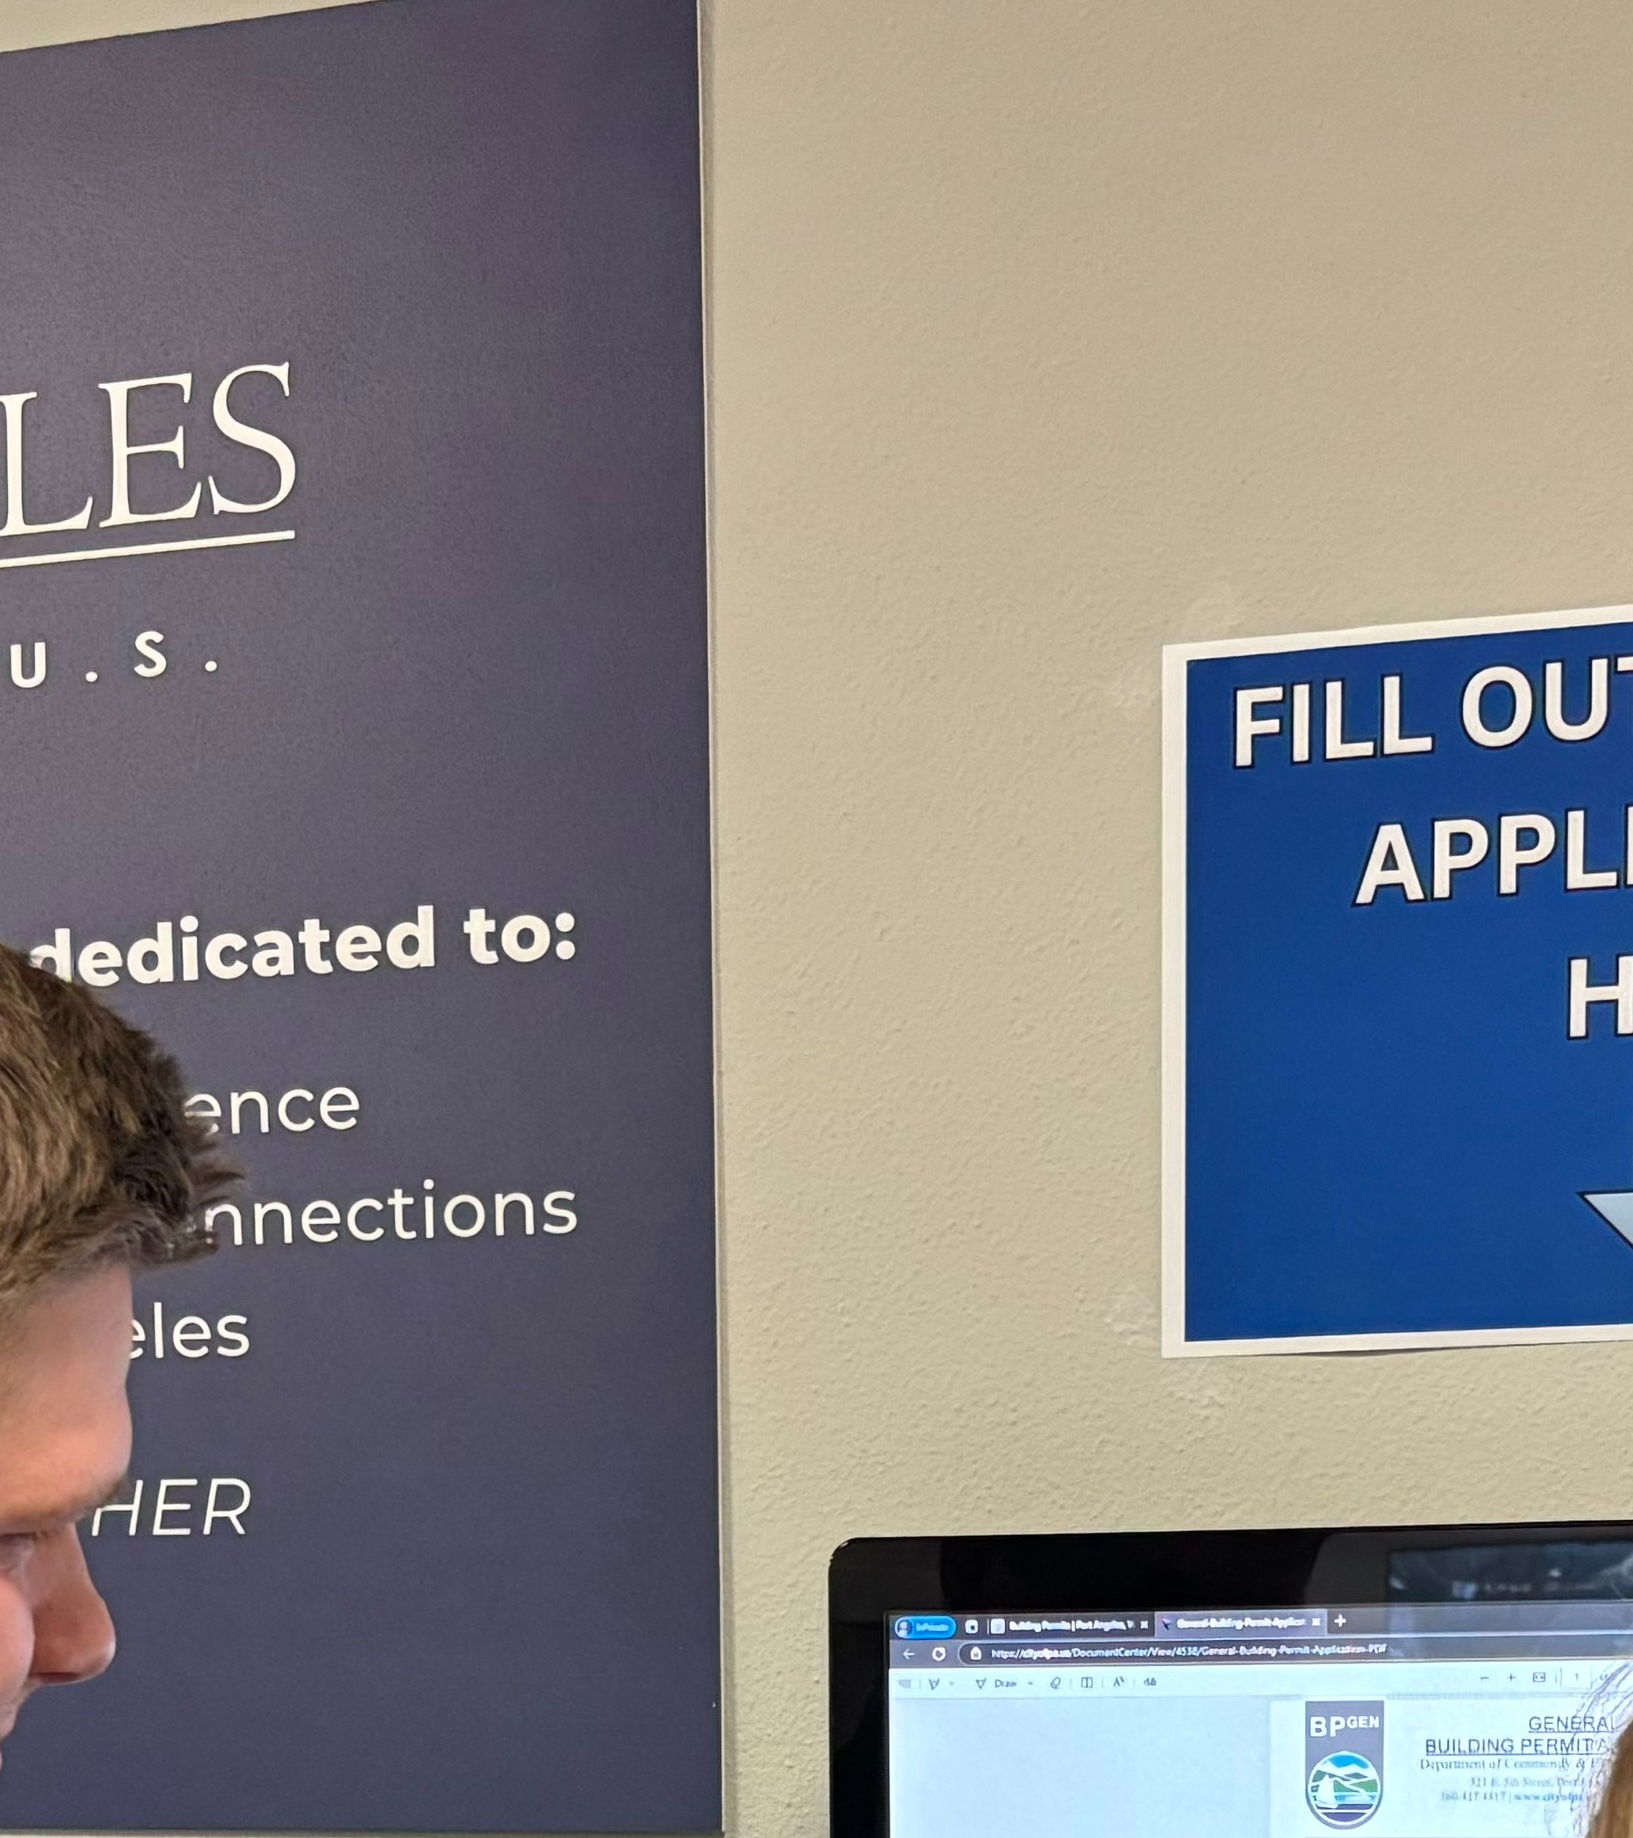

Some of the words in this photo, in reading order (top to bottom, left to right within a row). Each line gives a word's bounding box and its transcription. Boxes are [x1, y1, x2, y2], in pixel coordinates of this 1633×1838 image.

[10, 630, 218, 691] U.S.
[1235, 675, 1432, 766] FILL
[29, 904, 435, 987] dedicated
[462, 907, 575, 964] to:
[184, 1086, 359, 1134] ence
[204, 1178, 577, 1246] nnections
[125, 1301, 249, 1363] eles
[91, 1477, 251, 1536] HER
[1420, 1759, 1486, 1771] Department
[1426, 1738, 1514, 1754] BUILDING
[1520, 1738, 1594, 1753] PERMIT
